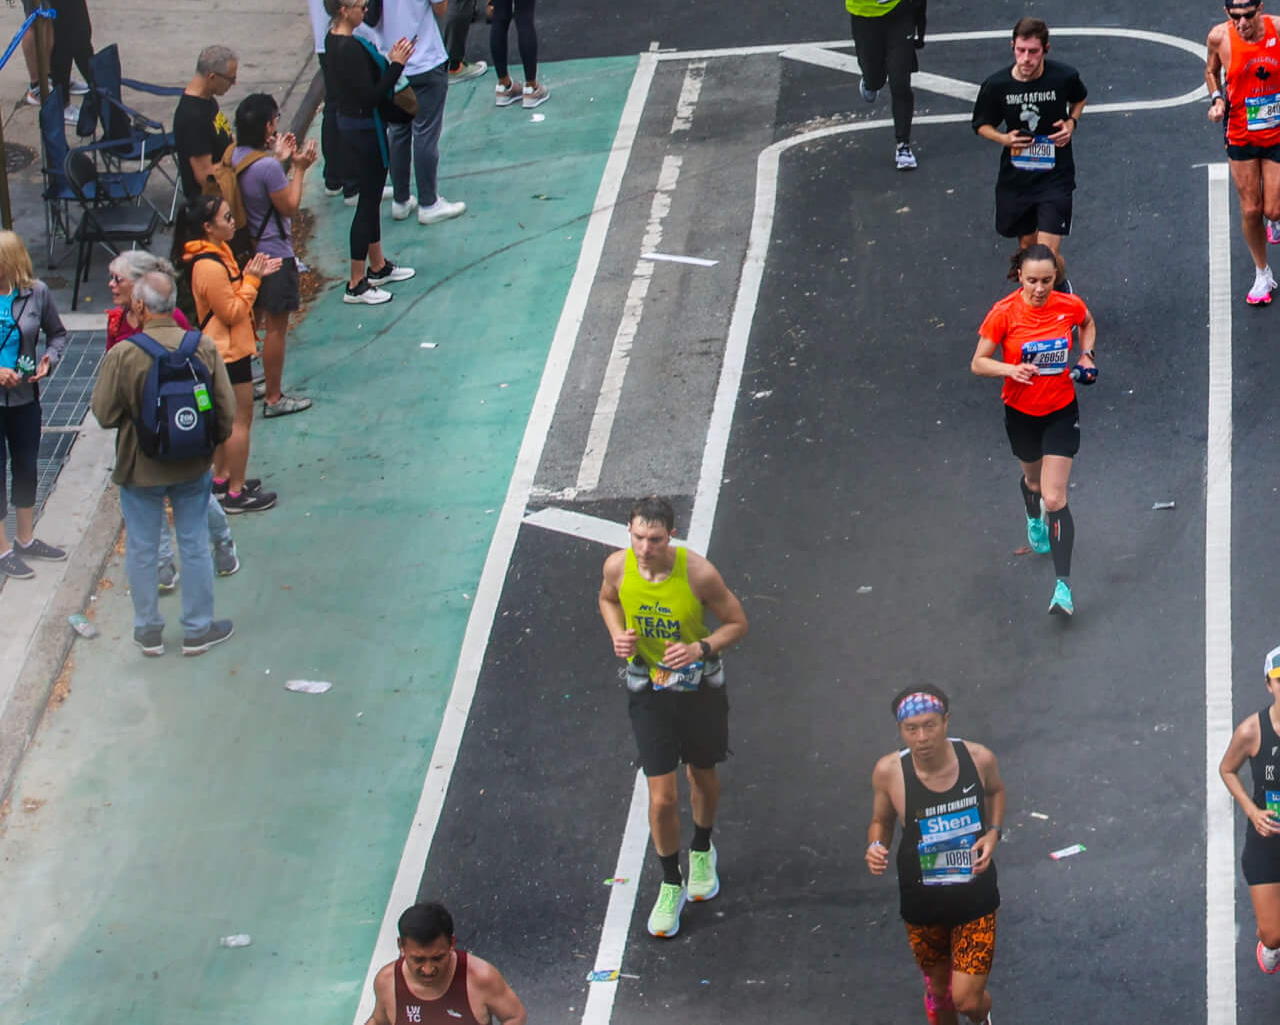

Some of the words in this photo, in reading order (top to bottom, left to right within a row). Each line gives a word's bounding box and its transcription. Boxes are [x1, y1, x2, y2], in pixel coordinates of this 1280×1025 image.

[635, 616, 680, 631] TEAM
[644, 628, 681, 642] KIDS
[927, 814, 971, 833] Shen
[406, 1005, 421, 1015] LW
[408, 1014, 421, 1023] TC
